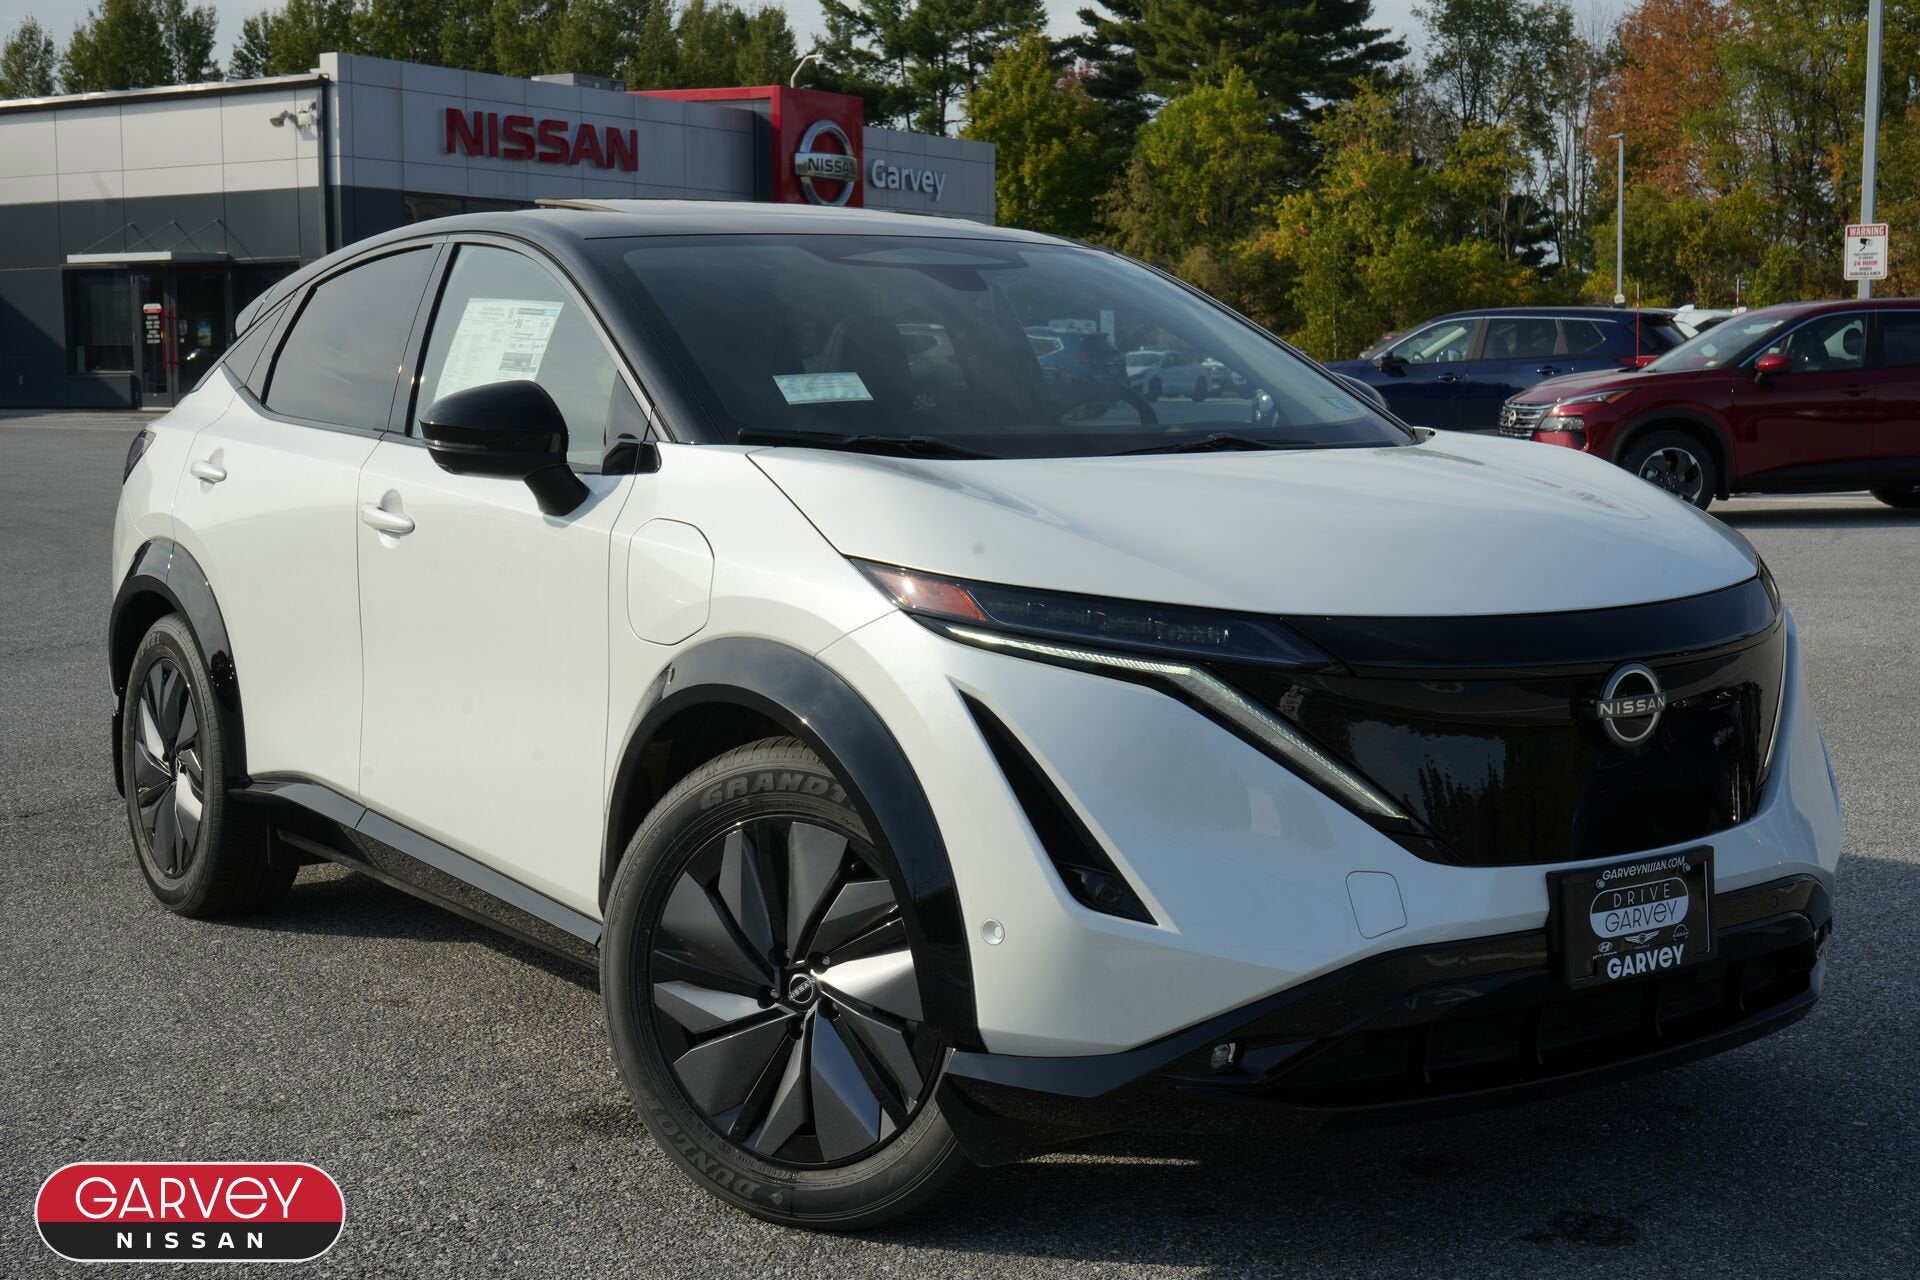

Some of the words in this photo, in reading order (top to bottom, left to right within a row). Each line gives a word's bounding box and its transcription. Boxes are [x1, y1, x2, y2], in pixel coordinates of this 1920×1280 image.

[445, 107, 639, 173] NISSAN
[870, 159, 946, 201] Garvey
[1849, 227, 1884, 236] WARNING
[1599, 696, 1666, 716] NISSAN
[1613, 882, 1670, 909] DRIVE
